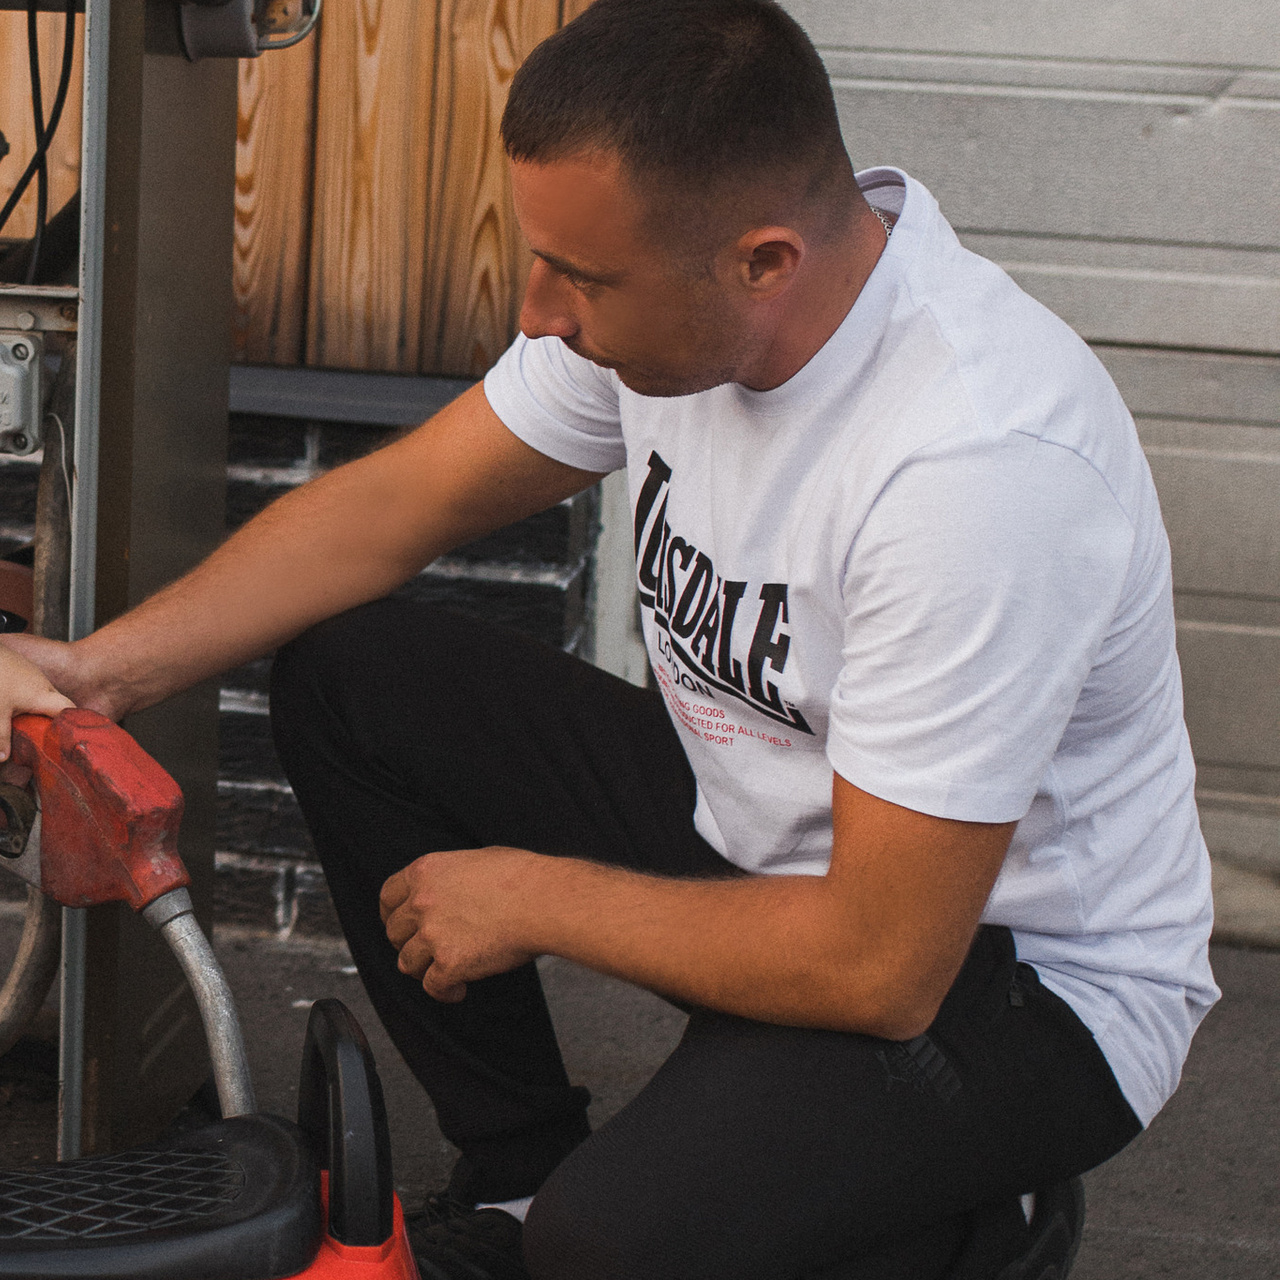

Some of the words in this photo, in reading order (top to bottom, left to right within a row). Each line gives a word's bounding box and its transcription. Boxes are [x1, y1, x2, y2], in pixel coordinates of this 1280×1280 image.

[657, 631, 715, 699] LODON
[692, 704, 726, 720] GOODS
[703, 732, 734, 747] SPORT
[715, 723, 735, 734] FOR
[737, 725, 754, 738] ALL
[757, 732, 792, 748] LEVELS
